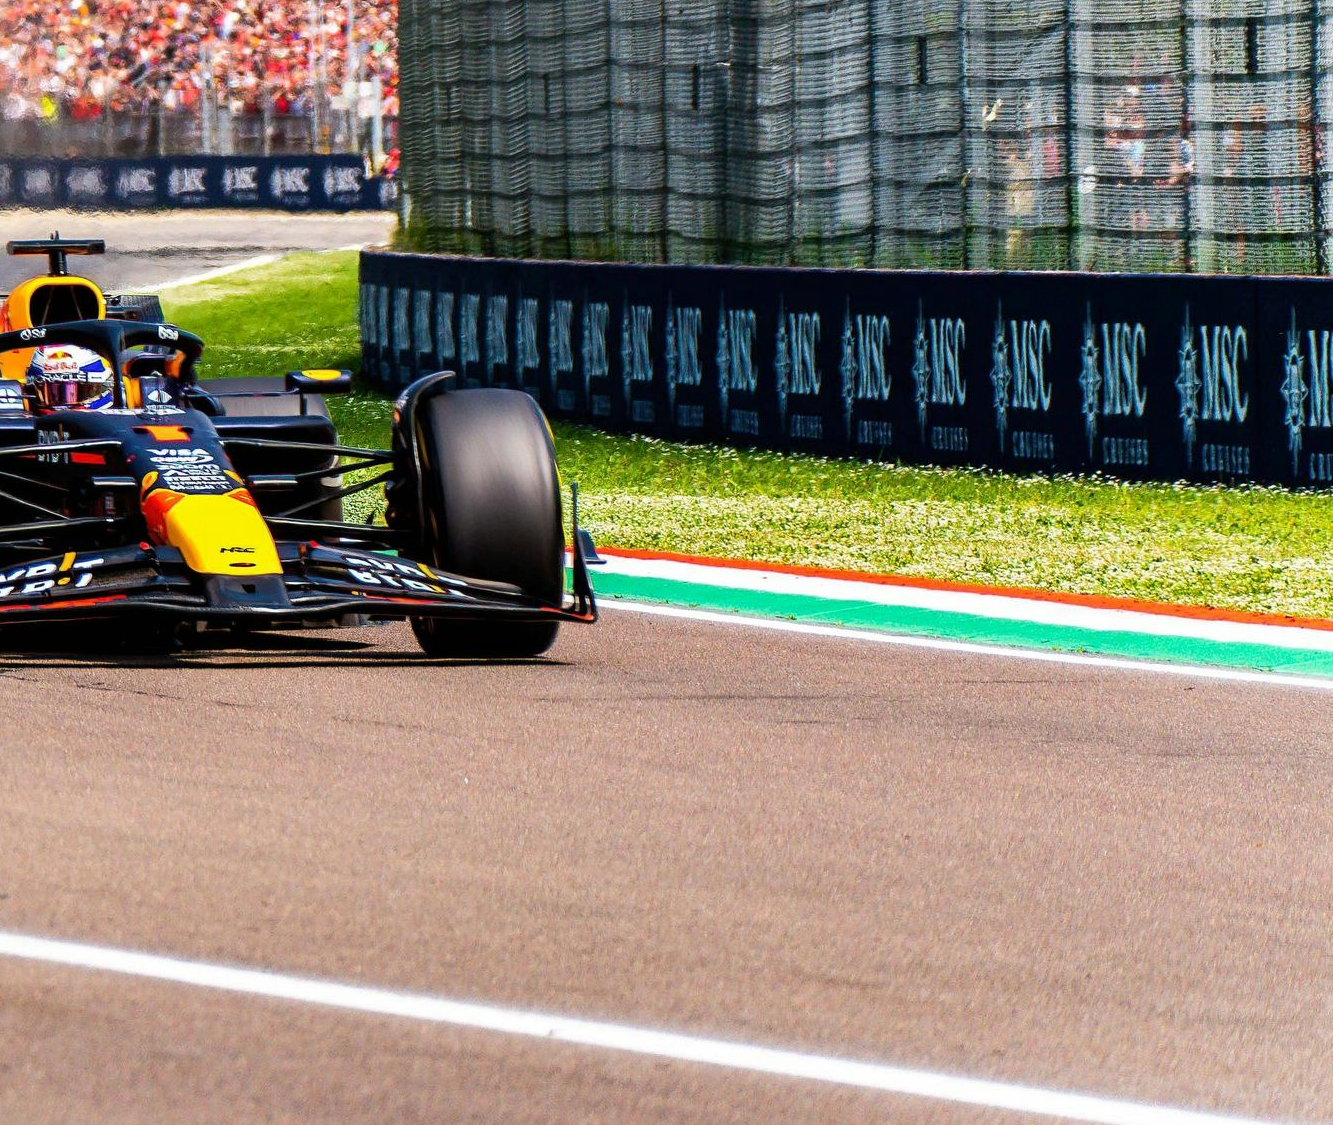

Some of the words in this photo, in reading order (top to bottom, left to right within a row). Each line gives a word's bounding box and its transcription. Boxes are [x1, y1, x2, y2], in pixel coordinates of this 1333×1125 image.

[856, 314, 892, 401] MSC
[930, 317, 967, 405] MSC
[1010, 319, 1052, 412] MSC
[1100, 323, 1148, 417] MSC
[1200, 325, 1249, 424] MSC
[146, 448, 210, 456] VISA
